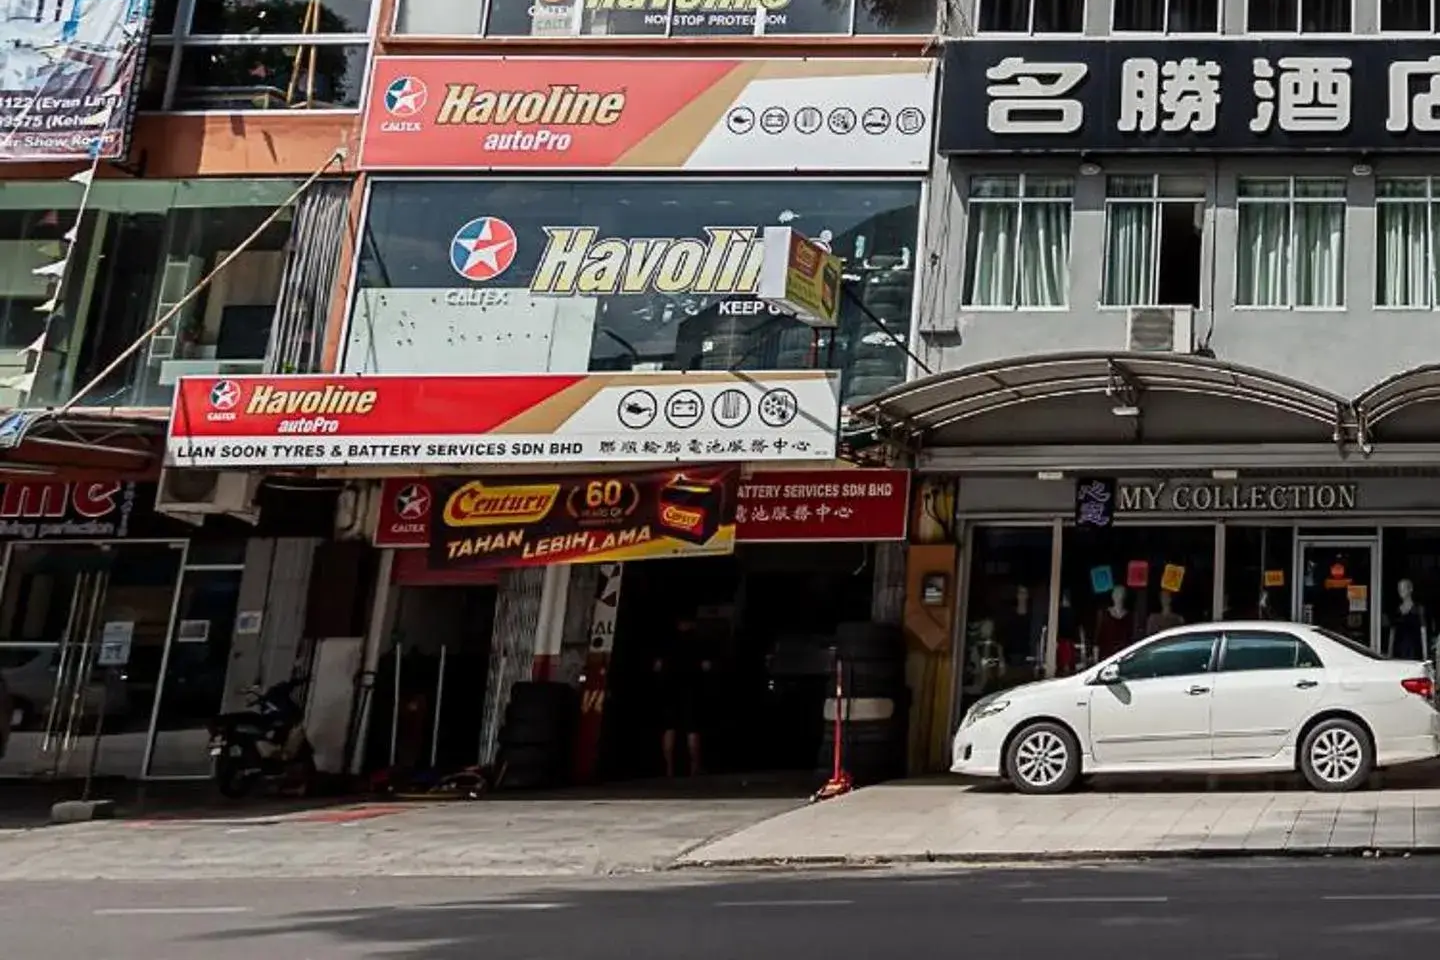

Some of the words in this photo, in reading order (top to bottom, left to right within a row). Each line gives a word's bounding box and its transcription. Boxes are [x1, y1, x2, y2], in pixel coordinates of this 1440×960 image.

[672, 14, 703, 25] STOP
[708, 14, 787, 25] PROTECON
[436, 83, 625, 126] Havoline
[380, 120, 423, 132] CALTEX
[484, 129, 571, 151] autoPro
[529, 226, 766, 296] Havoli
[719, 301, 765, 315] KEEP
[246, 385, 377, 414] Havoline
[277, 417, 338, 433] autoPro
[177, 445, 216, 458] LIAN
[220, 445, 266, 458] SOON
[271, 445, 326, 457] TYRES
[331, 445, 343, 457] &
[347, 444, 421, 456] BATTERY
[426, 443, 506, 456] SERVICES
[511, 443, 545, 455] SDN
[549, 443, 583, 454] BHD
[451, 488, 552, 520] Century
[586, 479, 622, 506] 60
[737, 485, 781, 498] ATTERY
[783, 484, 839, 498] SERVICES
[842, 484, 866, 497] SDN
[868, 484, 892, 496] BHD
[1119, 483, 1165, 510] MY
[1172, 484, 1357, 511] COLLECTION
[447, 528, 524, 560] TAHAN
[522, 531, 589, 559] LEBIH
[587, 525, 651, 553] LAMA
